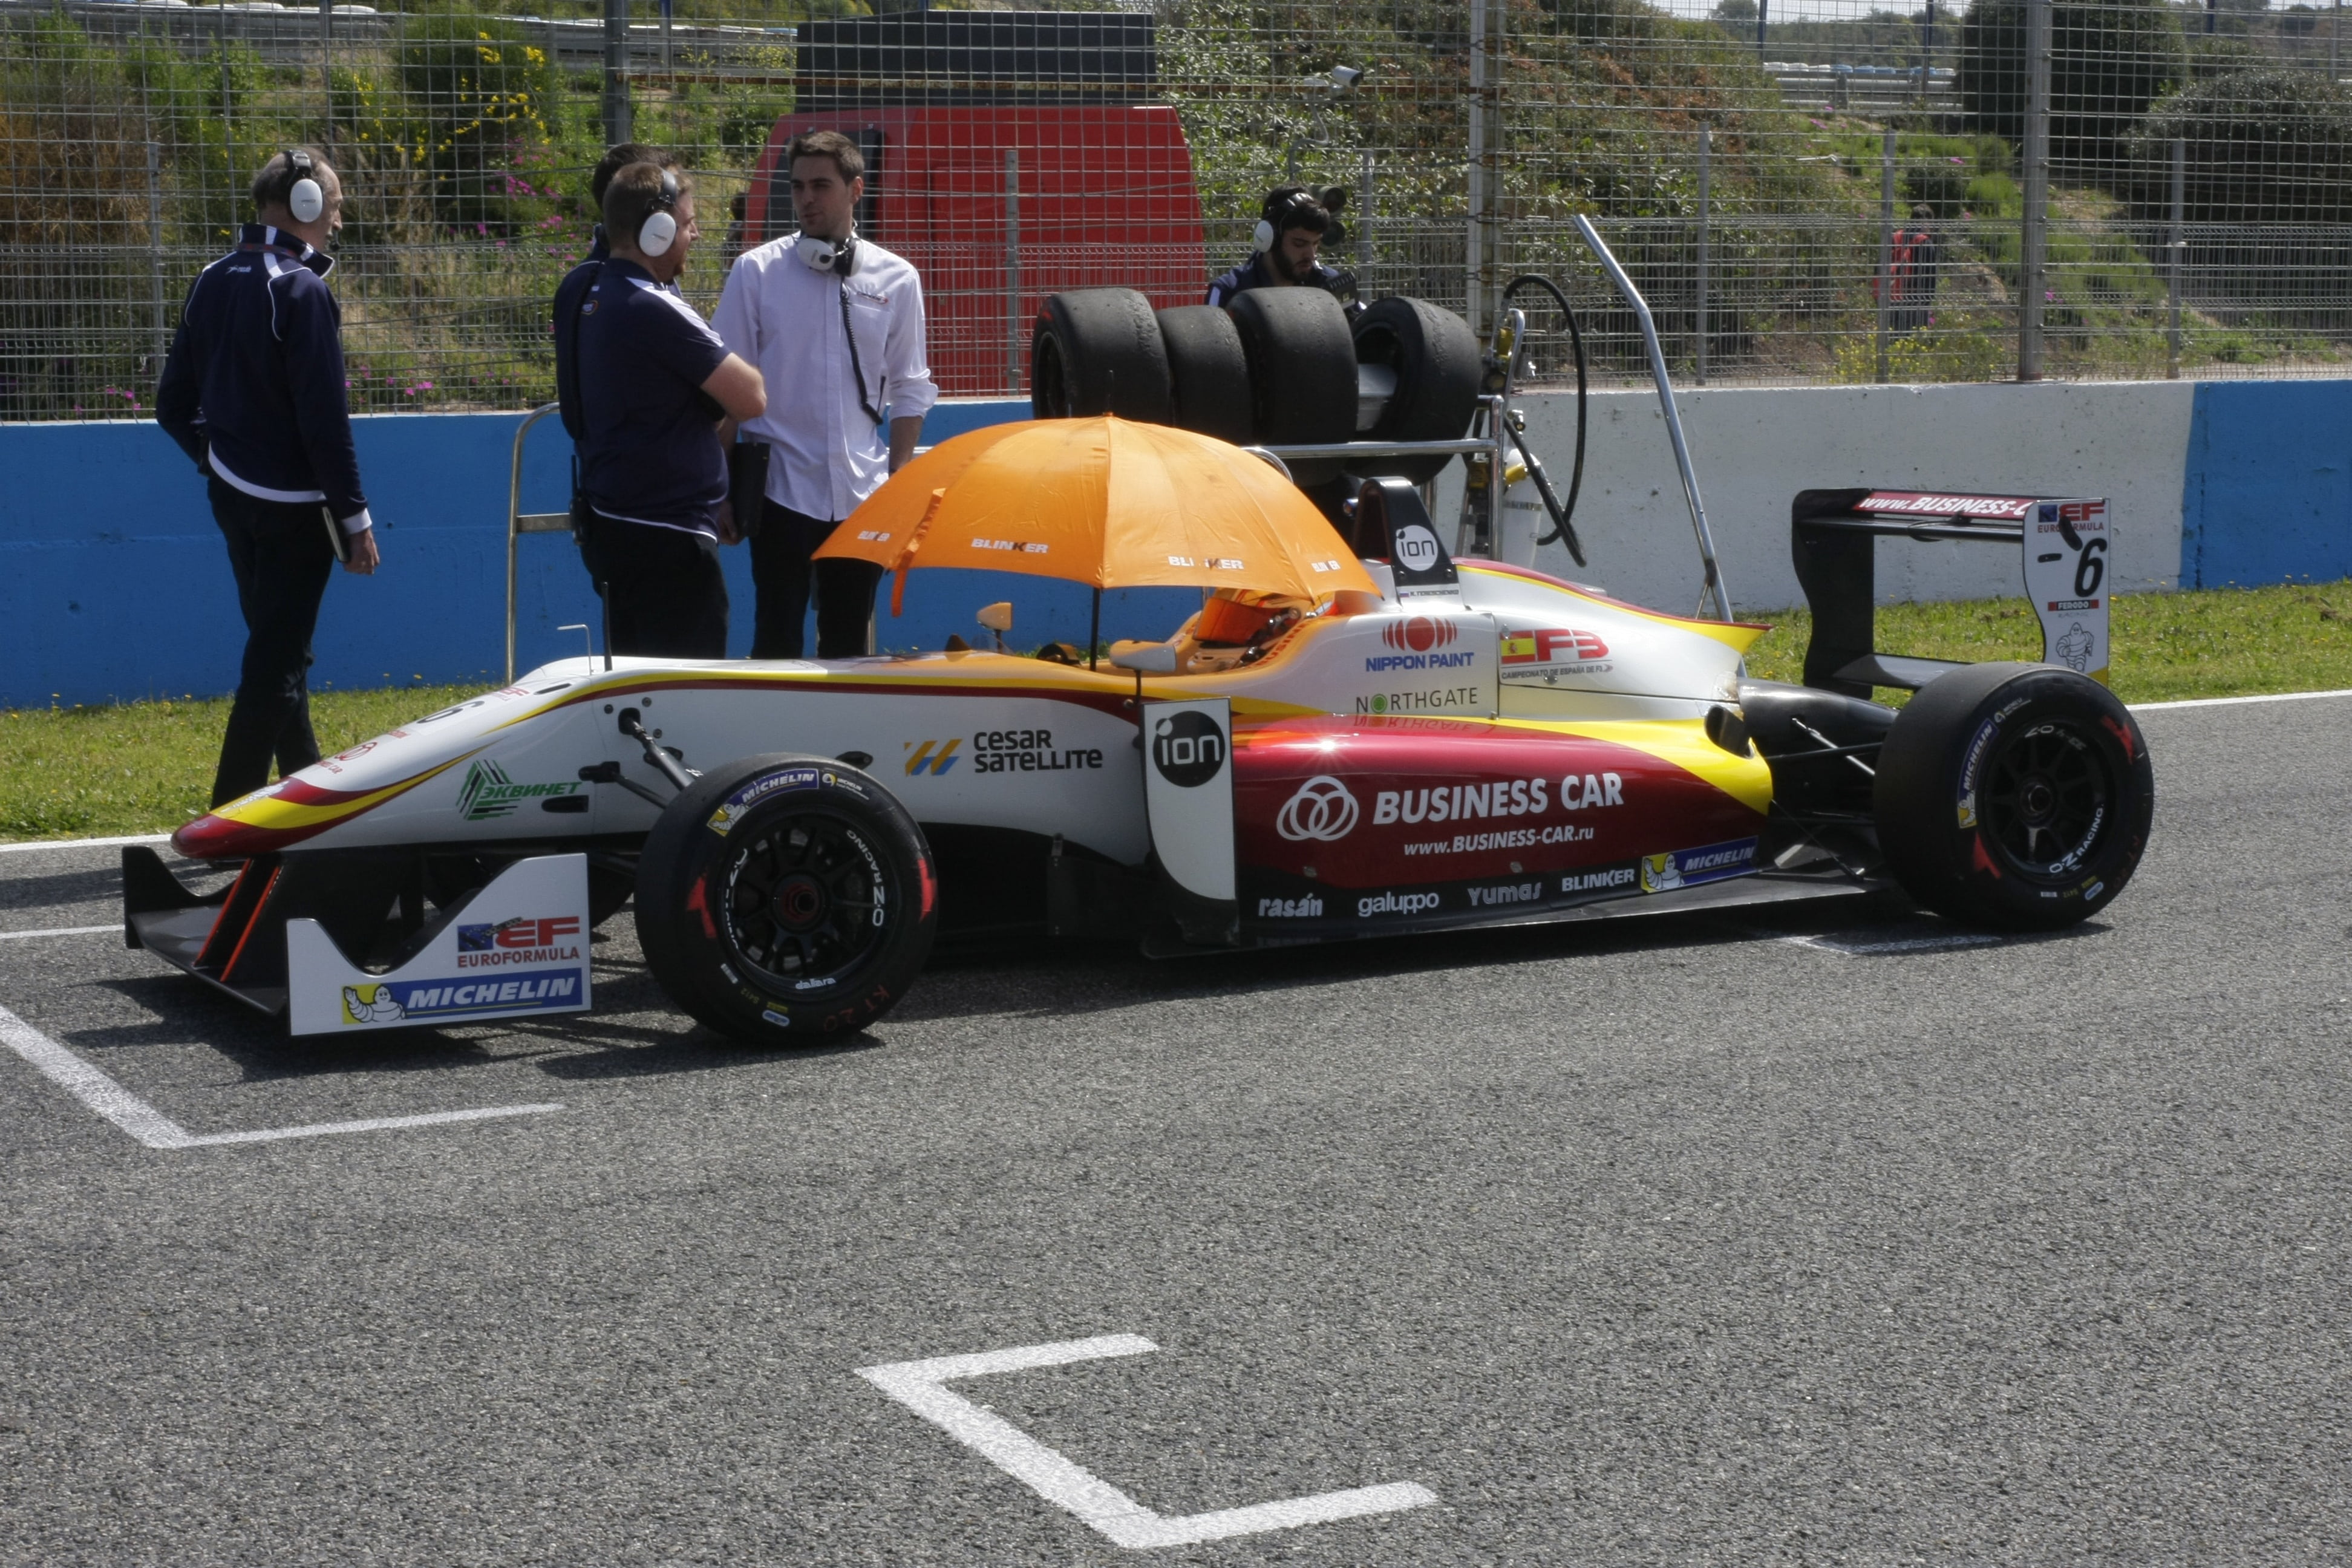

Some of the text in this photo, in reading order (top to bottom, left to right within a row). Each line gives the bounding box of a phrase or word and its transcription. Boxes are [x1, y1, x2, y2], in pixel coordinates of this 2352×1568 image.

[2059, 502, 2105, 521] EF
[2037, 522, 2105, 533] EURORMULA
[971, 538, 1049, 554] BLINKER
[1397, 531, 1434, 557] ion
[2074, 538, 2108, 597] 6
[2058, 601, 2089, 610] FERODO
[1535, 629, 1610, 661] F3
[1366, 652, 1474, 672] NIPPON PAINT
[1502, 669, 1549, 679] CAMPEONATO
[1560, 665, 1585, 675] ESPAÑA
[1356, 687, 1478, 714] NORTHGATE
[1156, 718, 1220, 766] ion
[1963, 724, 1992, 790] MICHELIN
[479, 781, 583, 799] ЭКВИНЕТ
[742, 774, 814, 803] MICHELIN
[1373, 773, 1624, 825] BUSINESS CAR
[1404, 825, 1595, 855] www.BUSINESS-CAR.ru
[847, 830, 882, 883] RACING
[1684, 846, 1754, 872] MICHELIN
[1562, 869, 1635, 892] BLINKER
[1258, 892, 1323, 916] rasán
[1357, 892, 1439, 917] galuppo
[1467, 883, 1543, 906] Yumas
[495, 916, 580, 949] EF
[457, 946, 580, 968] EUROFORMULA
[407, 977, 575, 1008] MICHELIN
[795, 978, 836, 990] dallara
